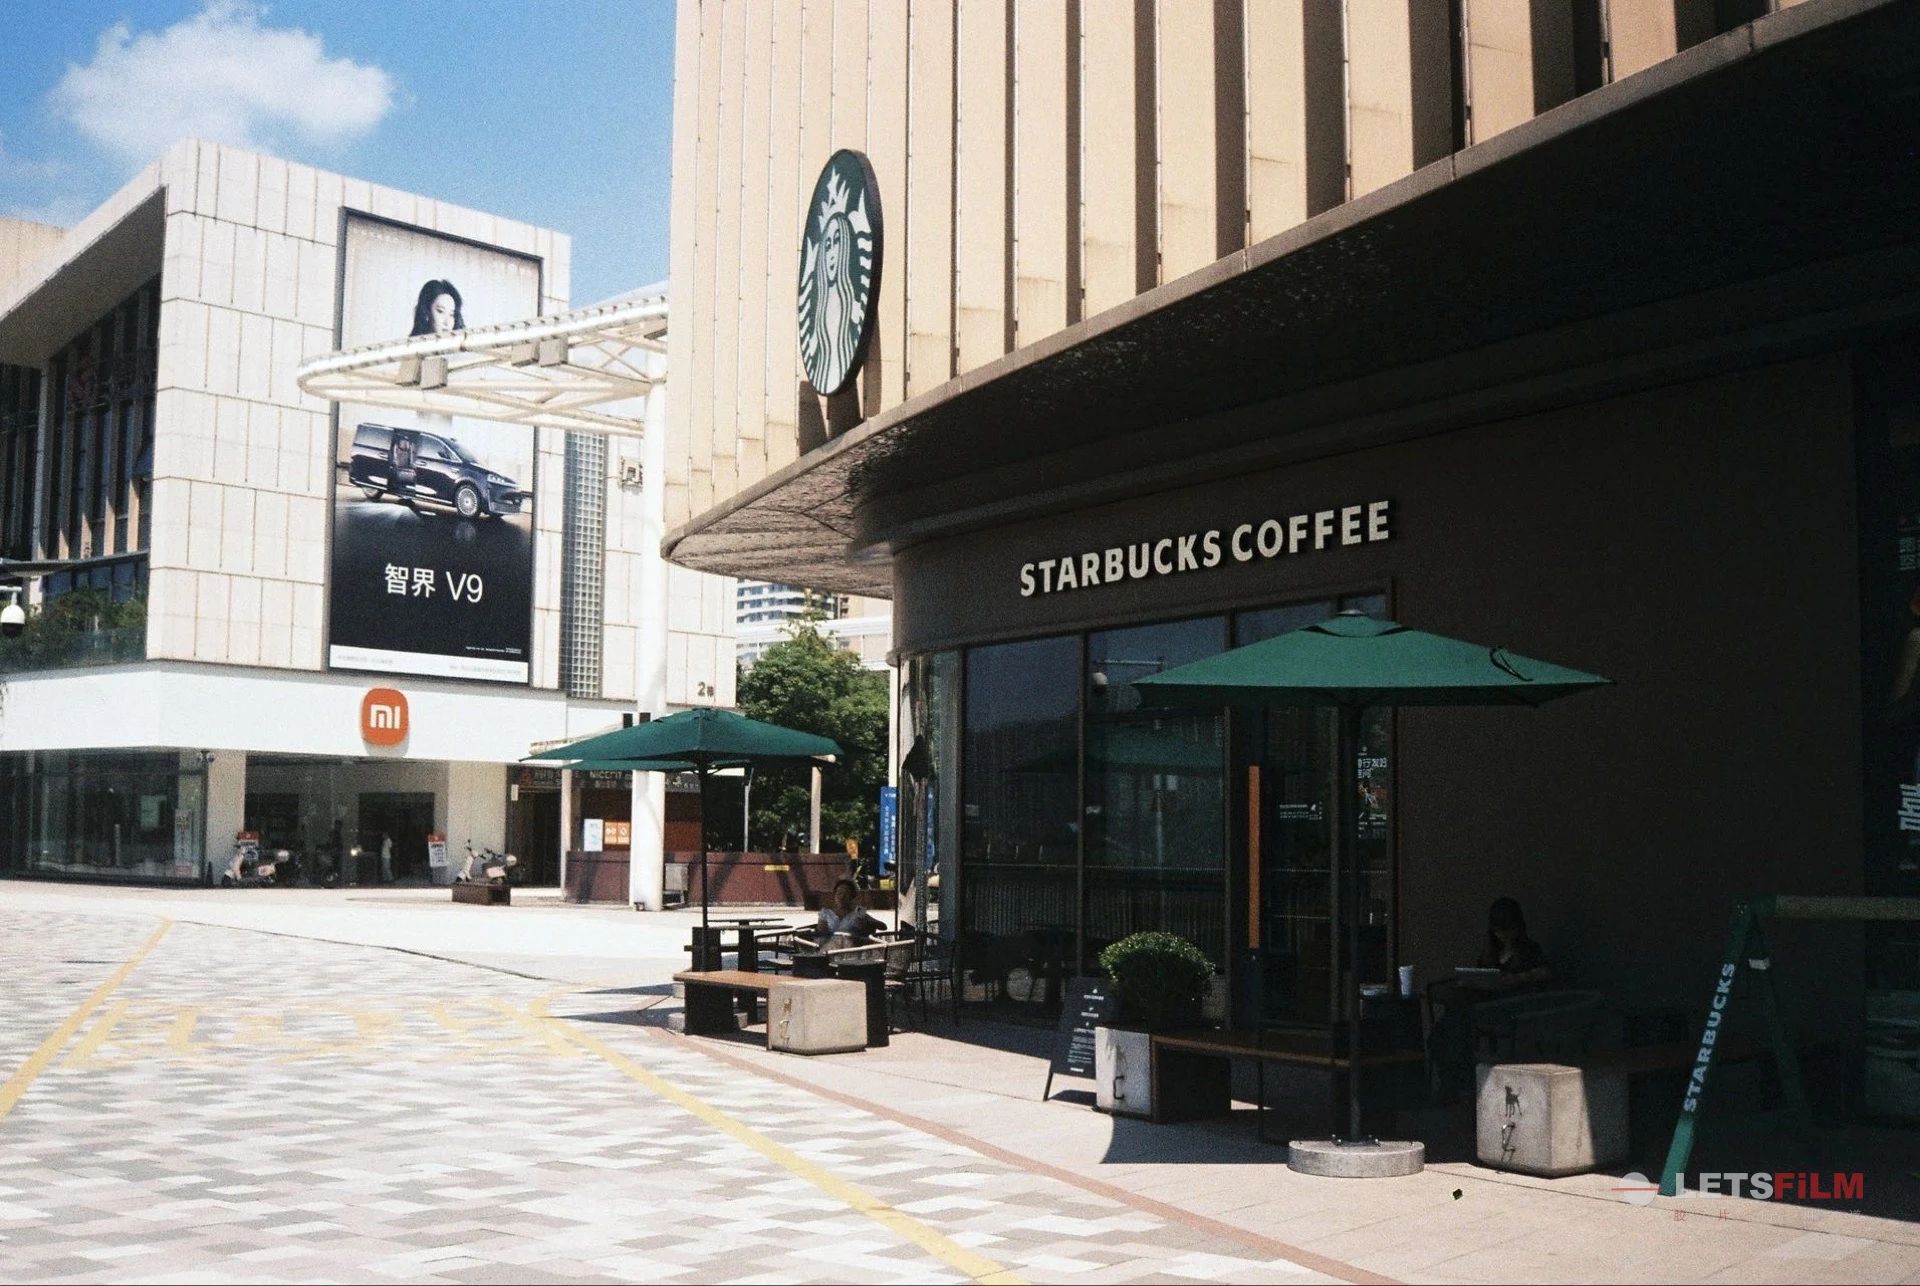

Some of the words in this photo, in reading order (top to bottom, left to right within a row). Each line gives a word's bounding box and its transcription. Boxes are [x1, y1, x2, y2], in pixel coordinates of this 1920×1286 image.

[384, 562, 436, 598] 智界
[445, 570, 483, 603] V9
[1020, 530, 1221, 597] STARBUCKS
[1231, 500, 1389, 562] COFFEE
[1683, 963, 1736, 1112] STARBUCKS
